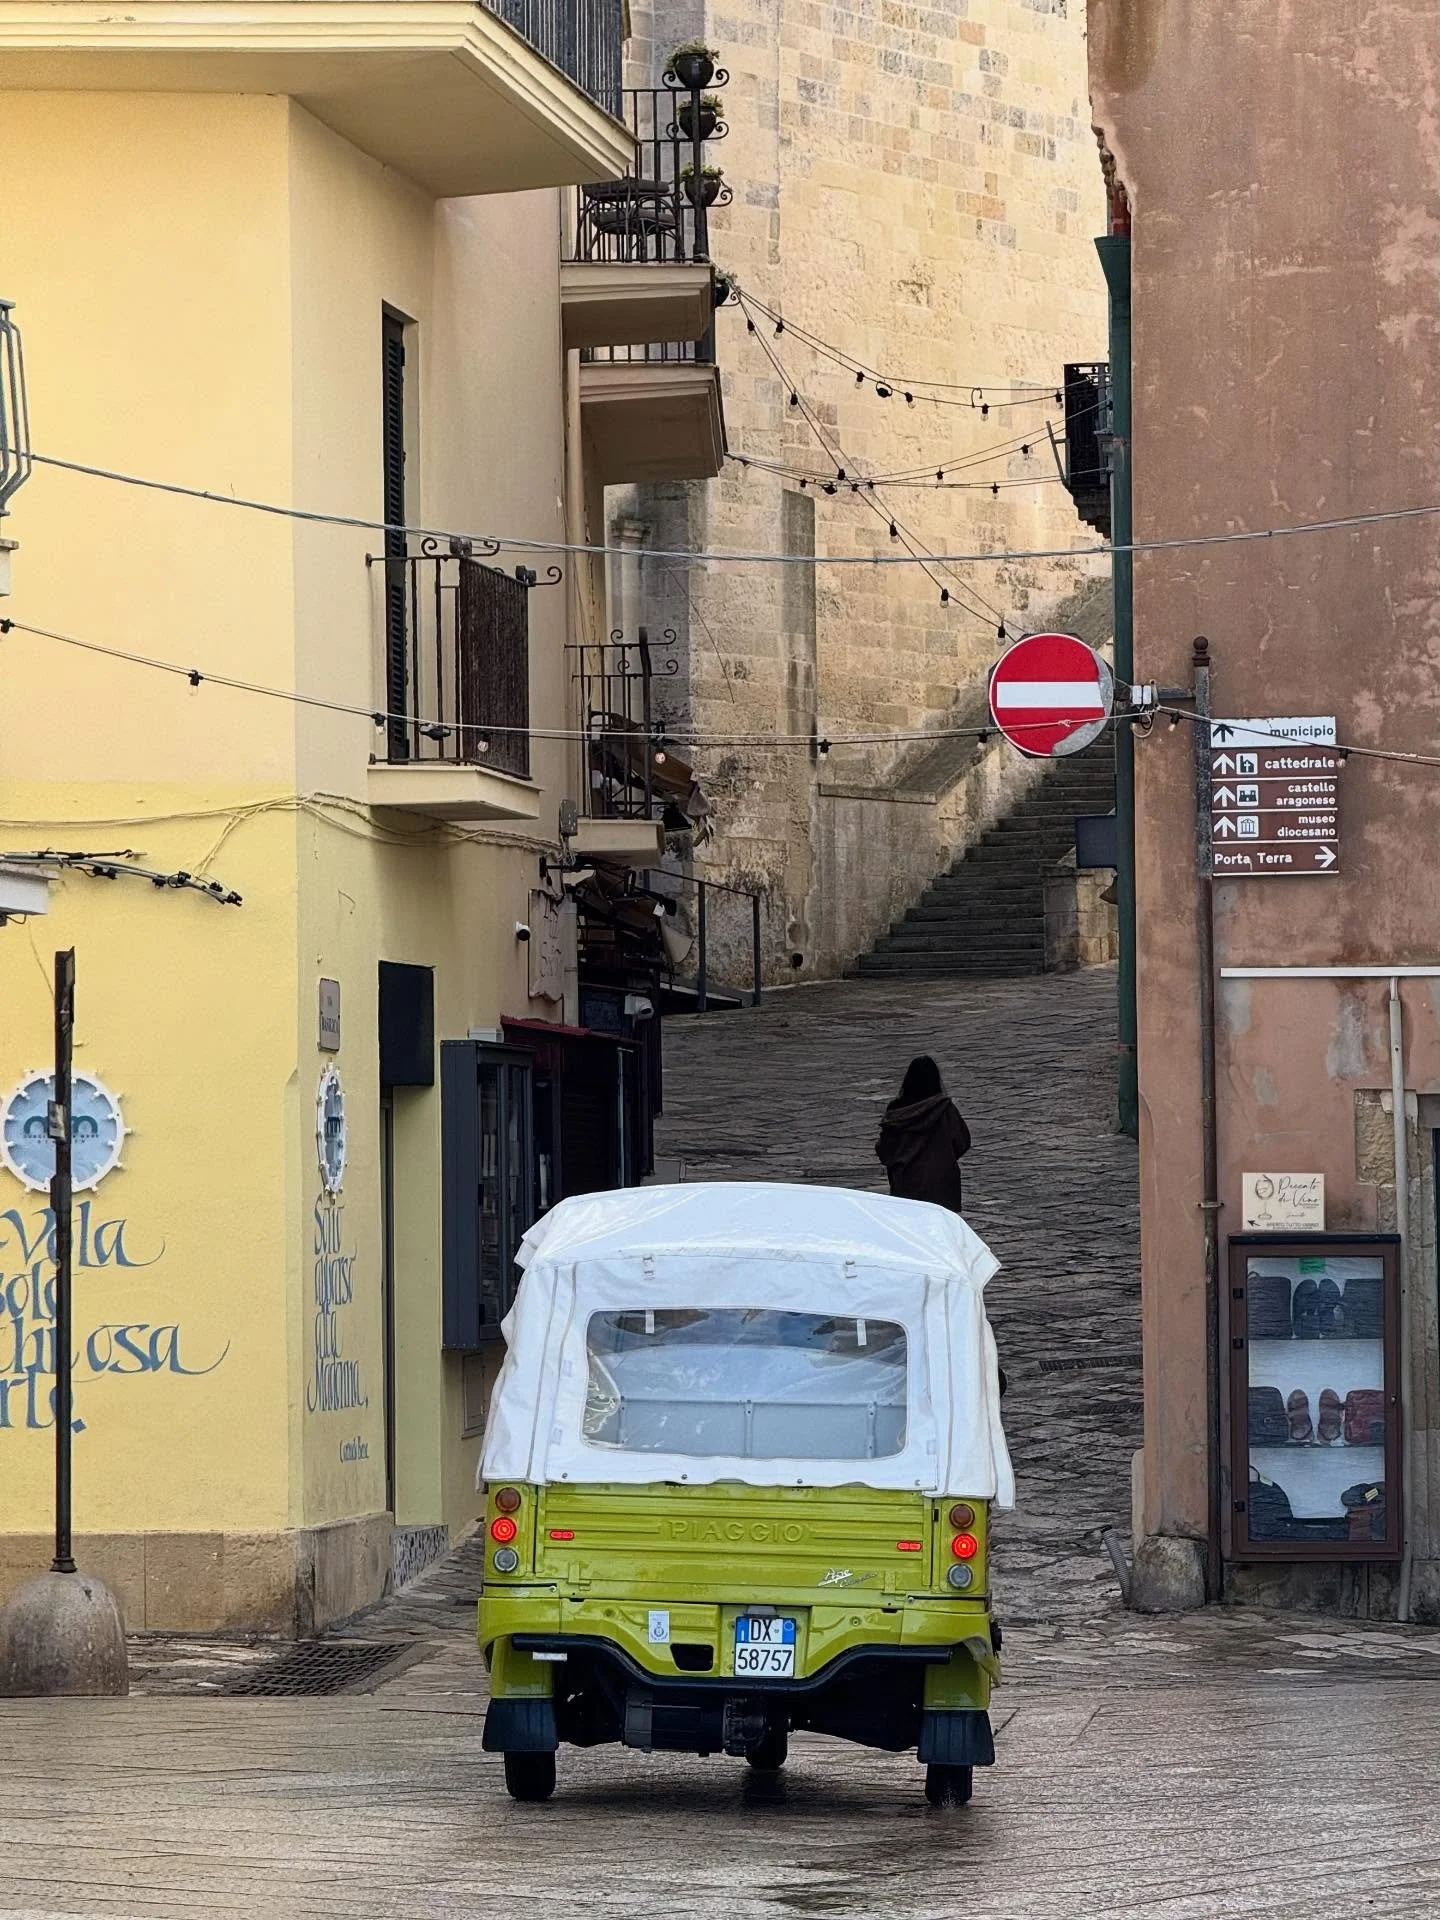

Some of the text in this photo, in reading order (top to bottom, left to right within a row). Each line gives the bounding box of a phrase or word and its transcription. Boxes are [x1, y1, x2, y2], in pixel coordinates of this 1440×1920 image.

[1270, 726, 1334, 738] municipio
[1264, 757, 1335, 769] cattedrale
[1287, 782, 1336, 793] castello
[1276, 796, 1336, 806] aragonese
[1298, 815, 1336, 824] museo
[1277, 826, 1336, 837] diocesano
[1214, 852, 1293, 865] Porta Terra
[1278, 1176, 1321, 1194] Peccato
[668, 1519, 804, 1543] PIAGGIO
[750, 1618, 772, 1642] DX
[737, 1648, 793, 1672] 58757
